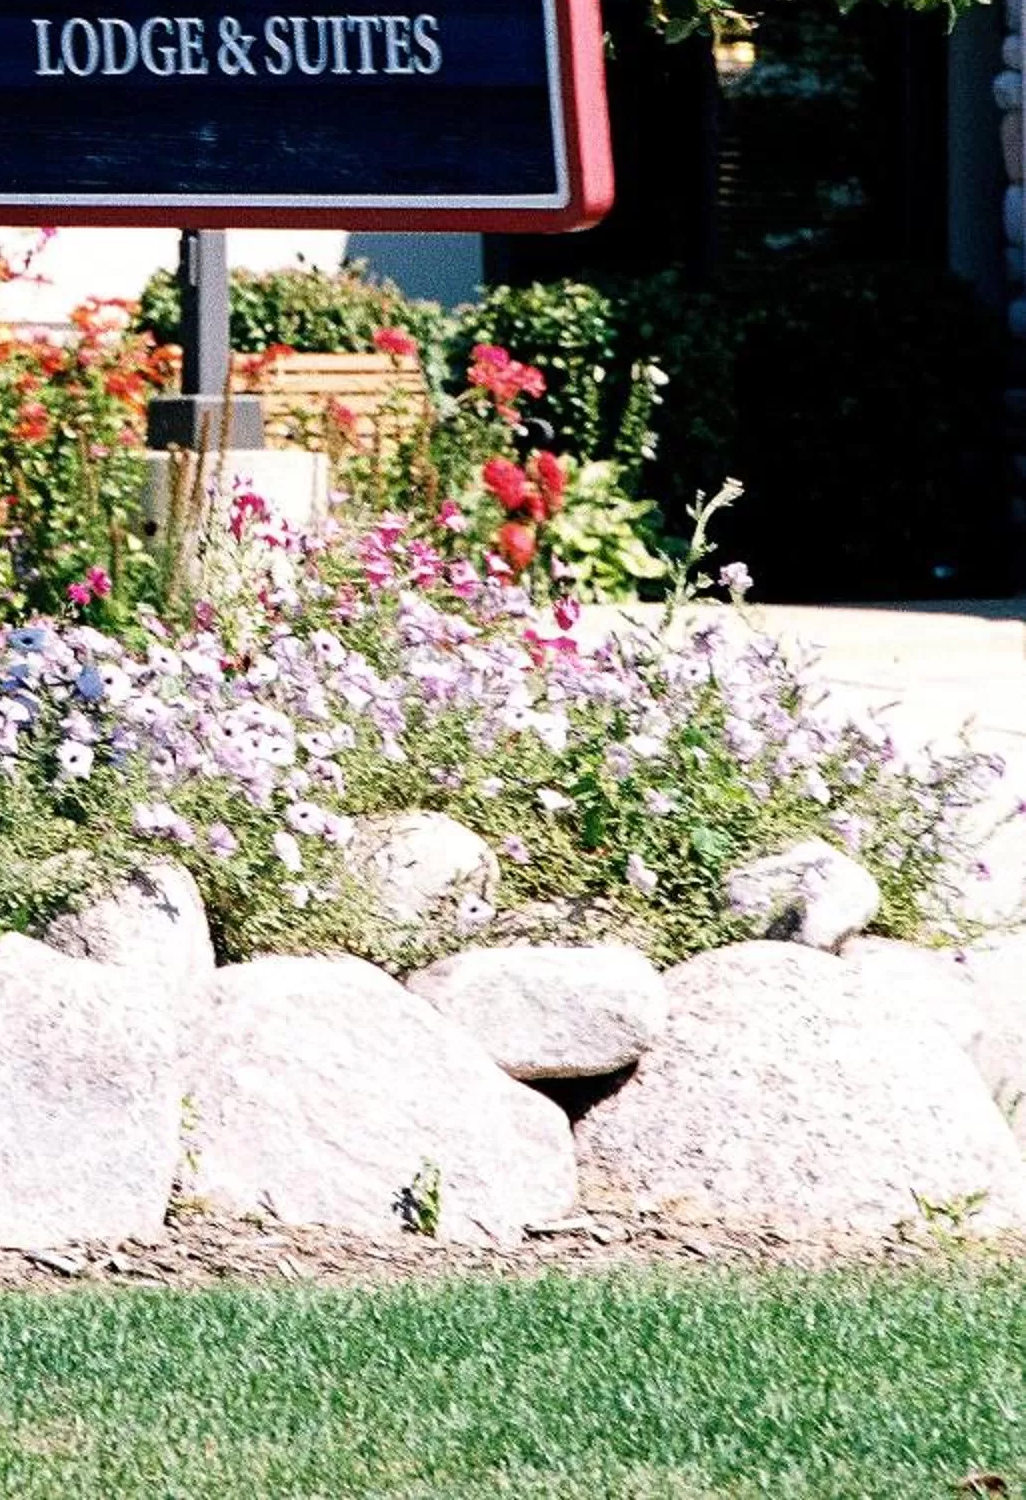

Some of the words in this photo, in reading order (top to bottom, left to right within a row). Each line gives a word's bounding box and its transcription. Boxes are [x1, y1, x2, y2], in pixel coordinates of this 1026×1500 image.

[32, 17, 209, 77] LODGE
[217, 16, 257, 76] &
[264, 14, 443, 75] SUITES
